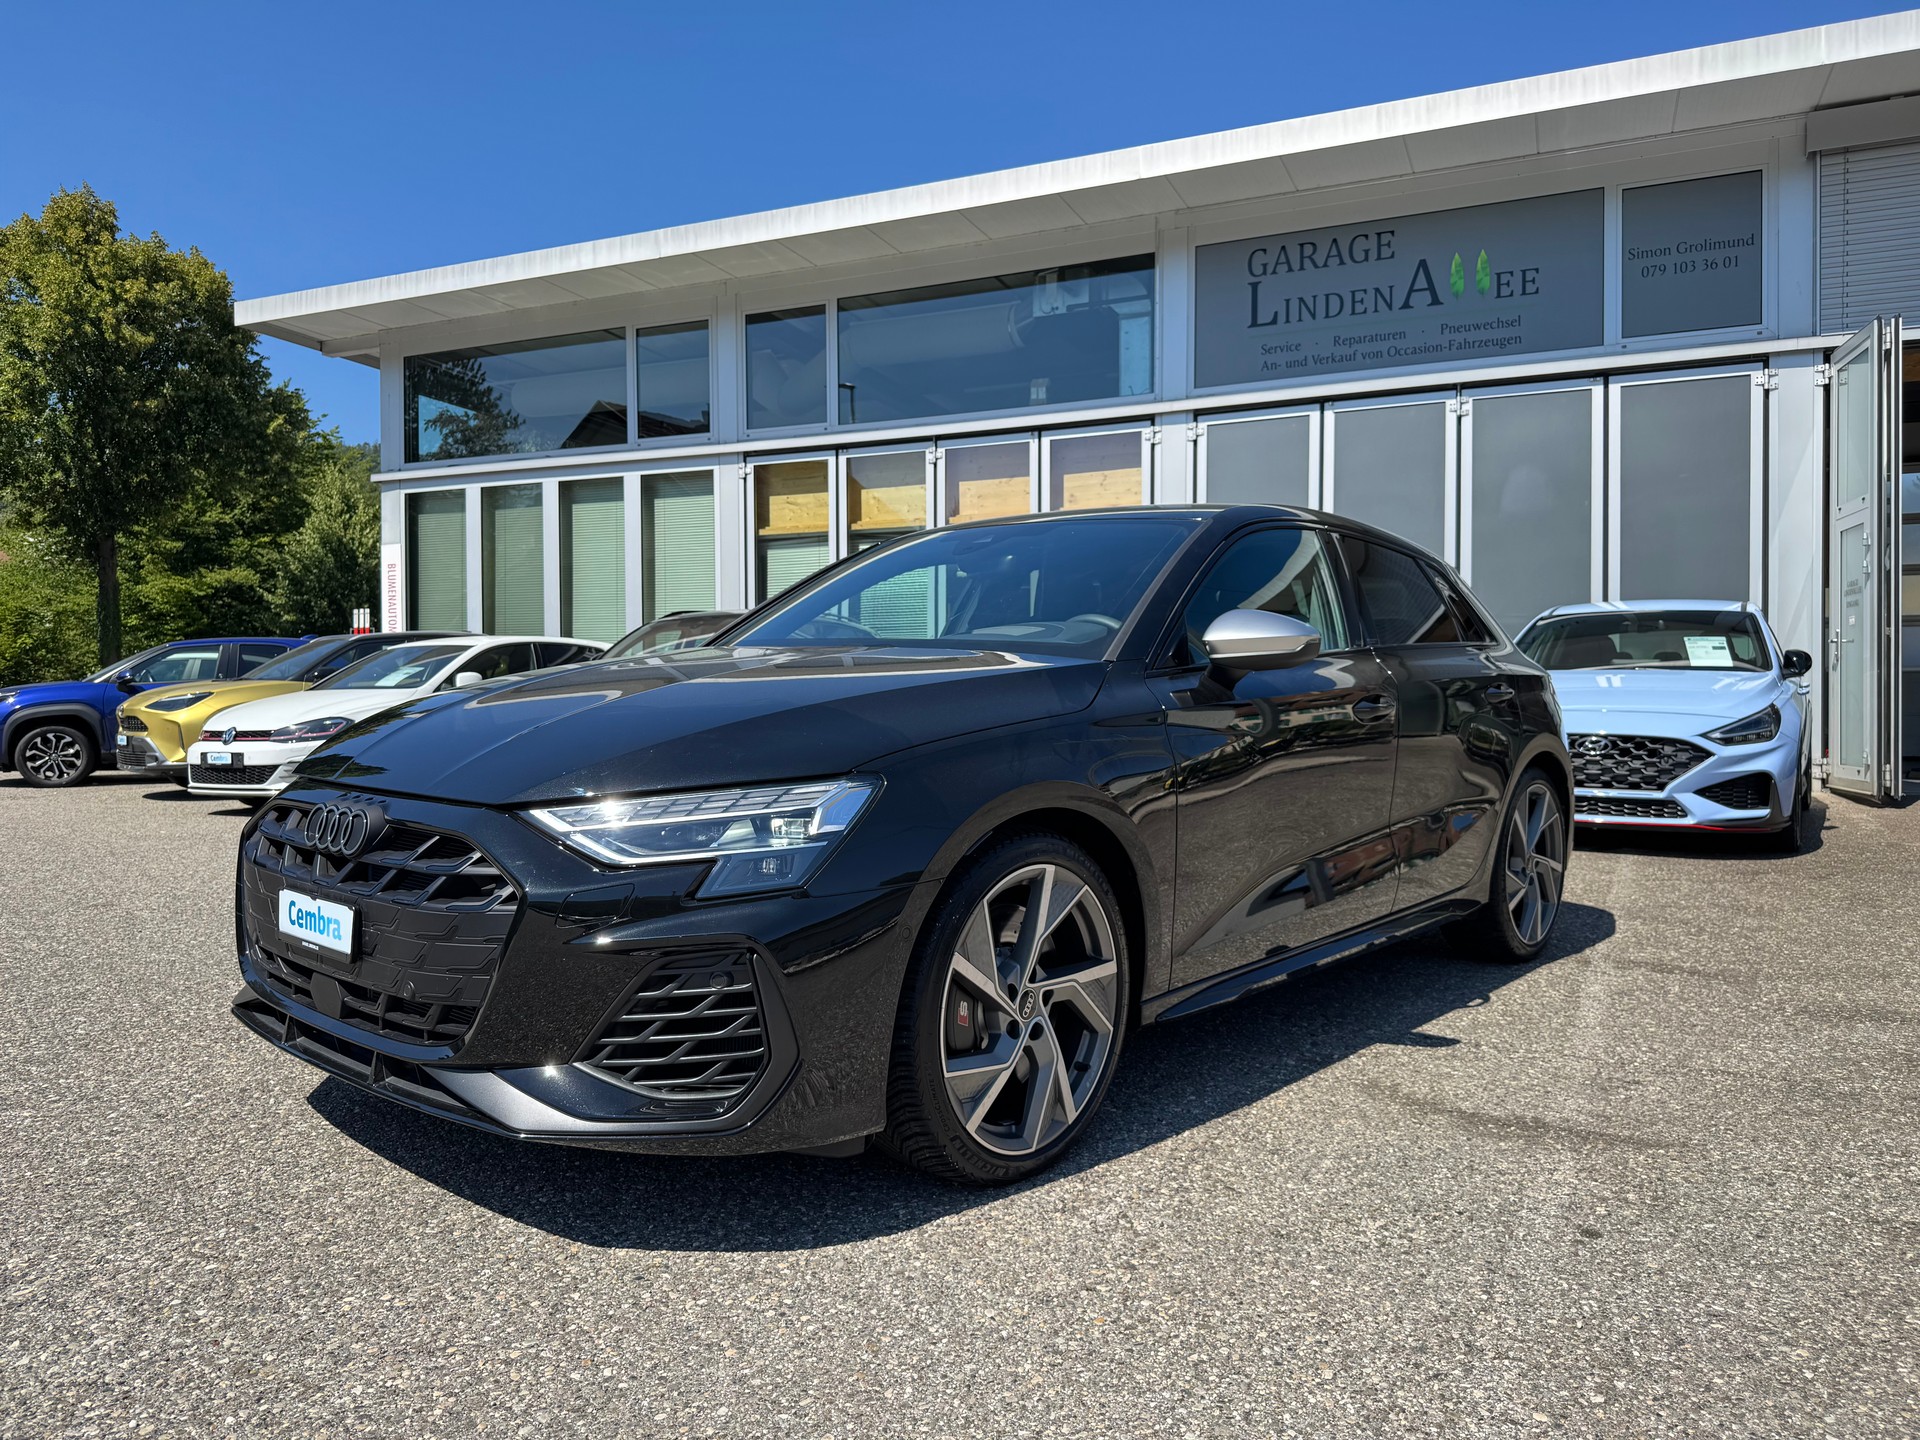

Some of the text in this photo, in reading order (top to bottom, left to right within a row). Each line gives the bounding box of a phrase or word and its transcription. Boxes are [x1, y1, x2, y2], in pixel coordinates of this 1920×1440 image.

[1247, 230, 1395, 278] GARAGE
[1628, 233, 1755, 261] Simon Grolimund
[1641, 255, 1739, 278] 079 103 36 01
[1260, 315, 1521, 356] Service Reparaturen Pneuwechsel
[1260, 335, 1522, 372] An- und Verkauf von Occasion-Fahrzeugen
[288, 900, 342, 941] Cembra
[952, 1137, 1008, 1177] MICHELIN
